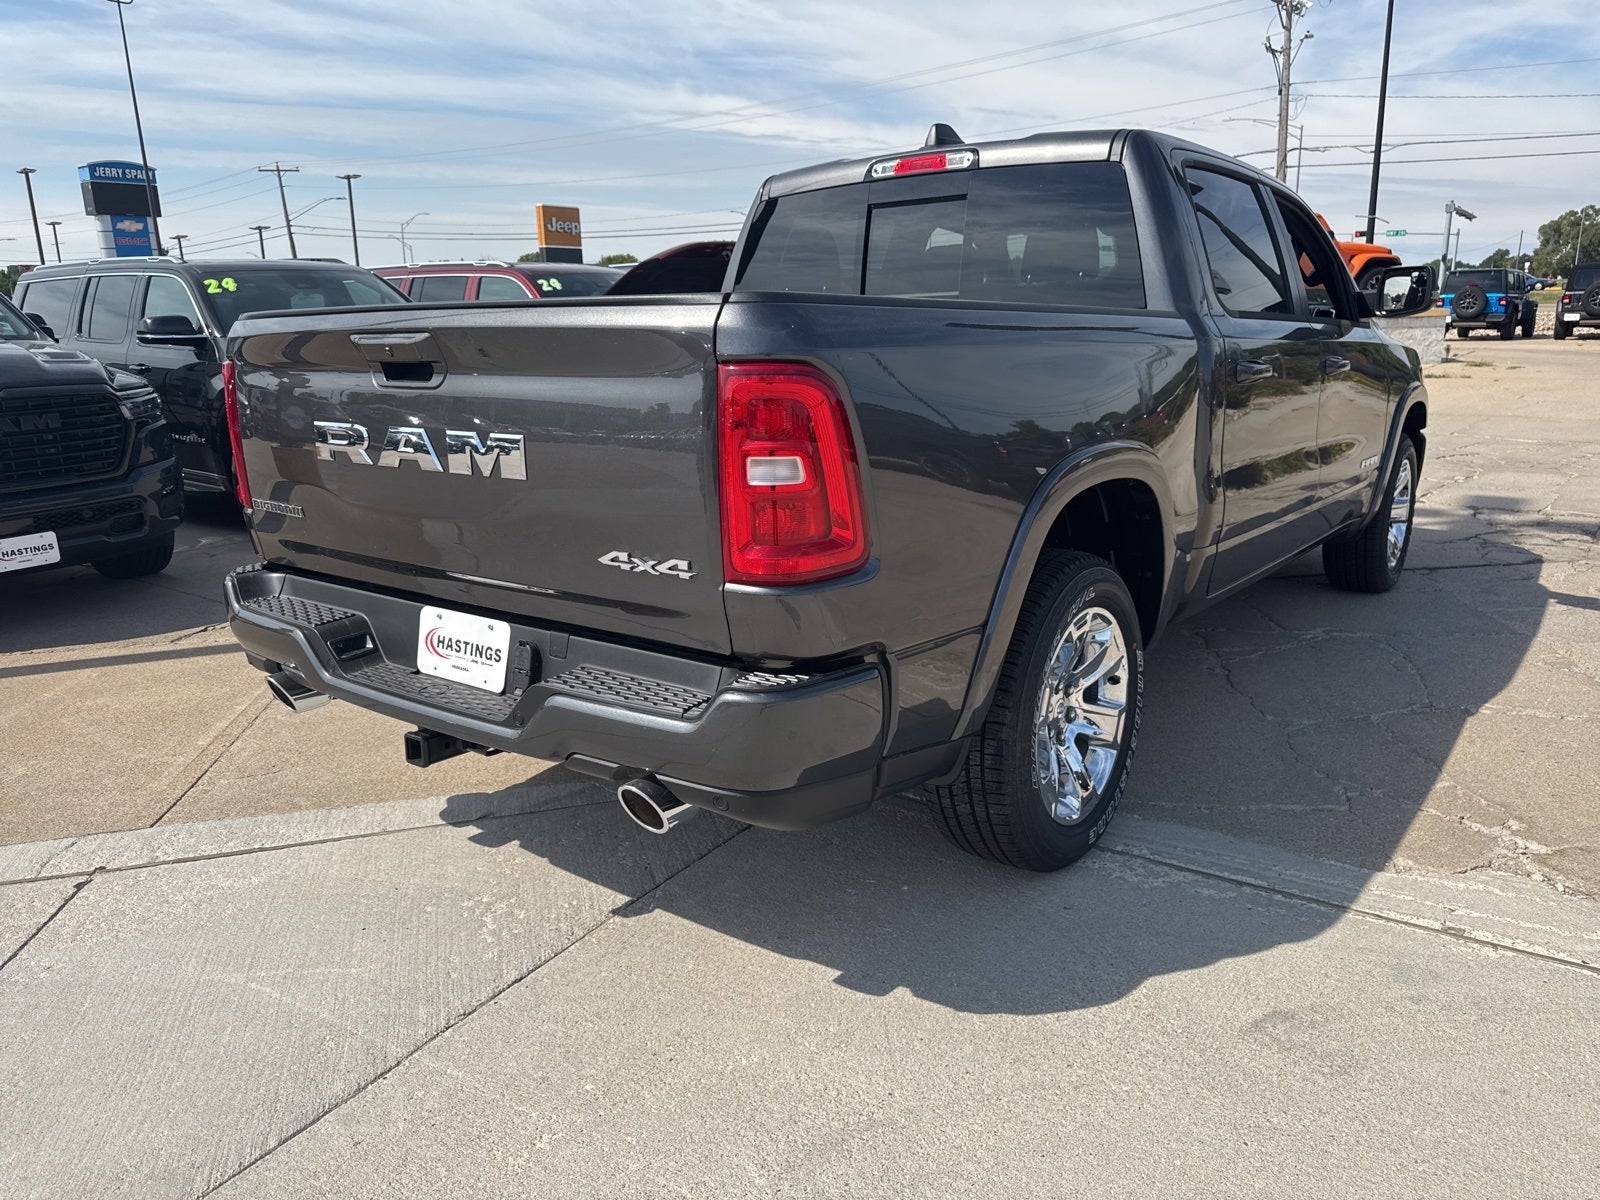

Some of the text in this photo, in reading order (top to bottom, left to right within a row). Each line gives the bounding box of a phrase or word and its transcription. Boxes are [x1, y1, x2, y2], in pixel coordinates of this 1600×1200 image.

[94, 166, 122, 178] JERRY
[546, 216, 580, 236] Jeep
[116, 236, 149, 246] GMC
[203, 277, 238, 294] 24
[536, 277, 563, 292] 24
[0, 413, 62, 431] AM
[313, 420, 528, 481] RAM
[2, 543, 54, 558] HASTINGS
[436, 634, 502, 663] HASTINGS
